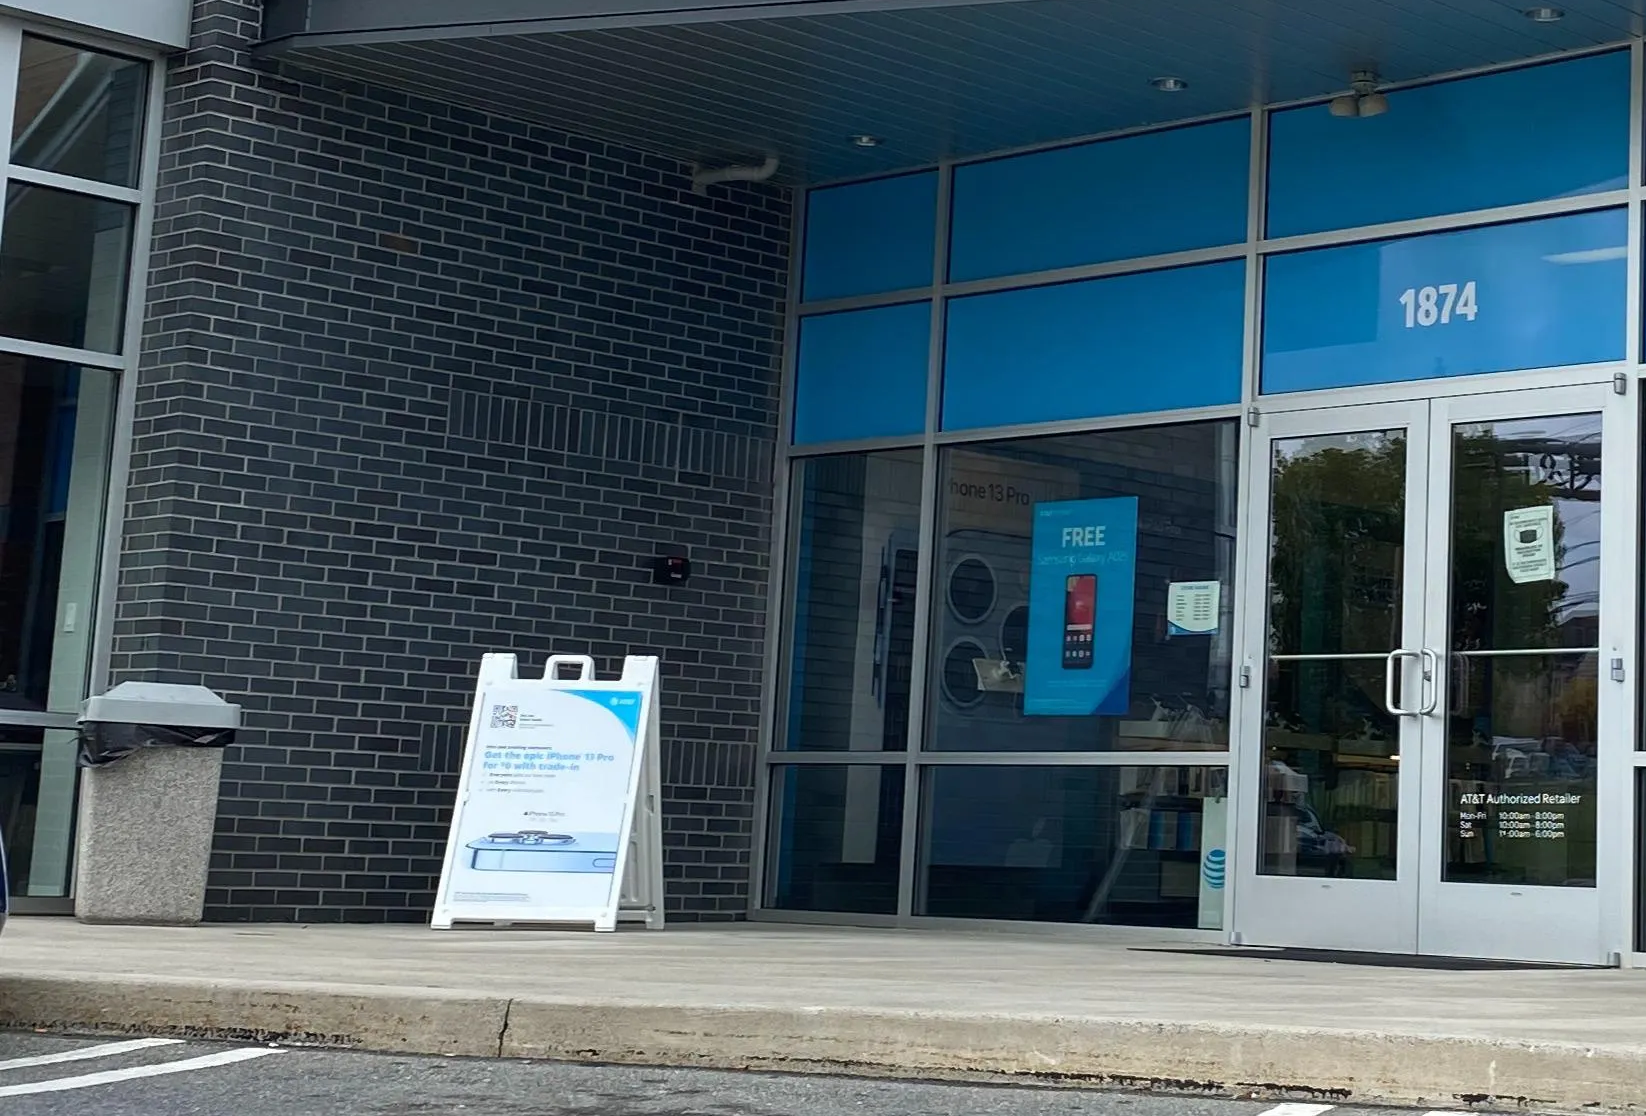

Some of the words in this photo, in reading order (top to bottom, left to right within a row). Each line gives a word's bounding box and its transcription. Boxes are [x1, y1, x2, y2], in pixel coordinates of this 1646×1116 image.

[1399, 281, 1478, 328] 1874
[950, 477, 986, 500] hone
[988, 483, 1004, 502] 13
[1006, 486, 1030, 505] Pro
[1061, 525, 1106, 548] FREE
[484, 751, 501, 759] Get
[505, 751, 521, 759] the
[547, 752, 581, 761] iPhone
[597, 753, 615, 761] Pro
[514, 762, 536, 770] with
[1460, 793, 1485, 804] AT&T
[1486, 793, 1541, 804] Authorized
[1542, 793, 1581, 804] Retailer
[1460, 811, 1487, 820] Mon-Fri
[1535, 811, 1565, 821] 8:00pm
[1460, 821, 1472, 829] Sat
[1535, 821, 1565, 830] 8:00pm
[1460, 830, 1474, 838] Sun
